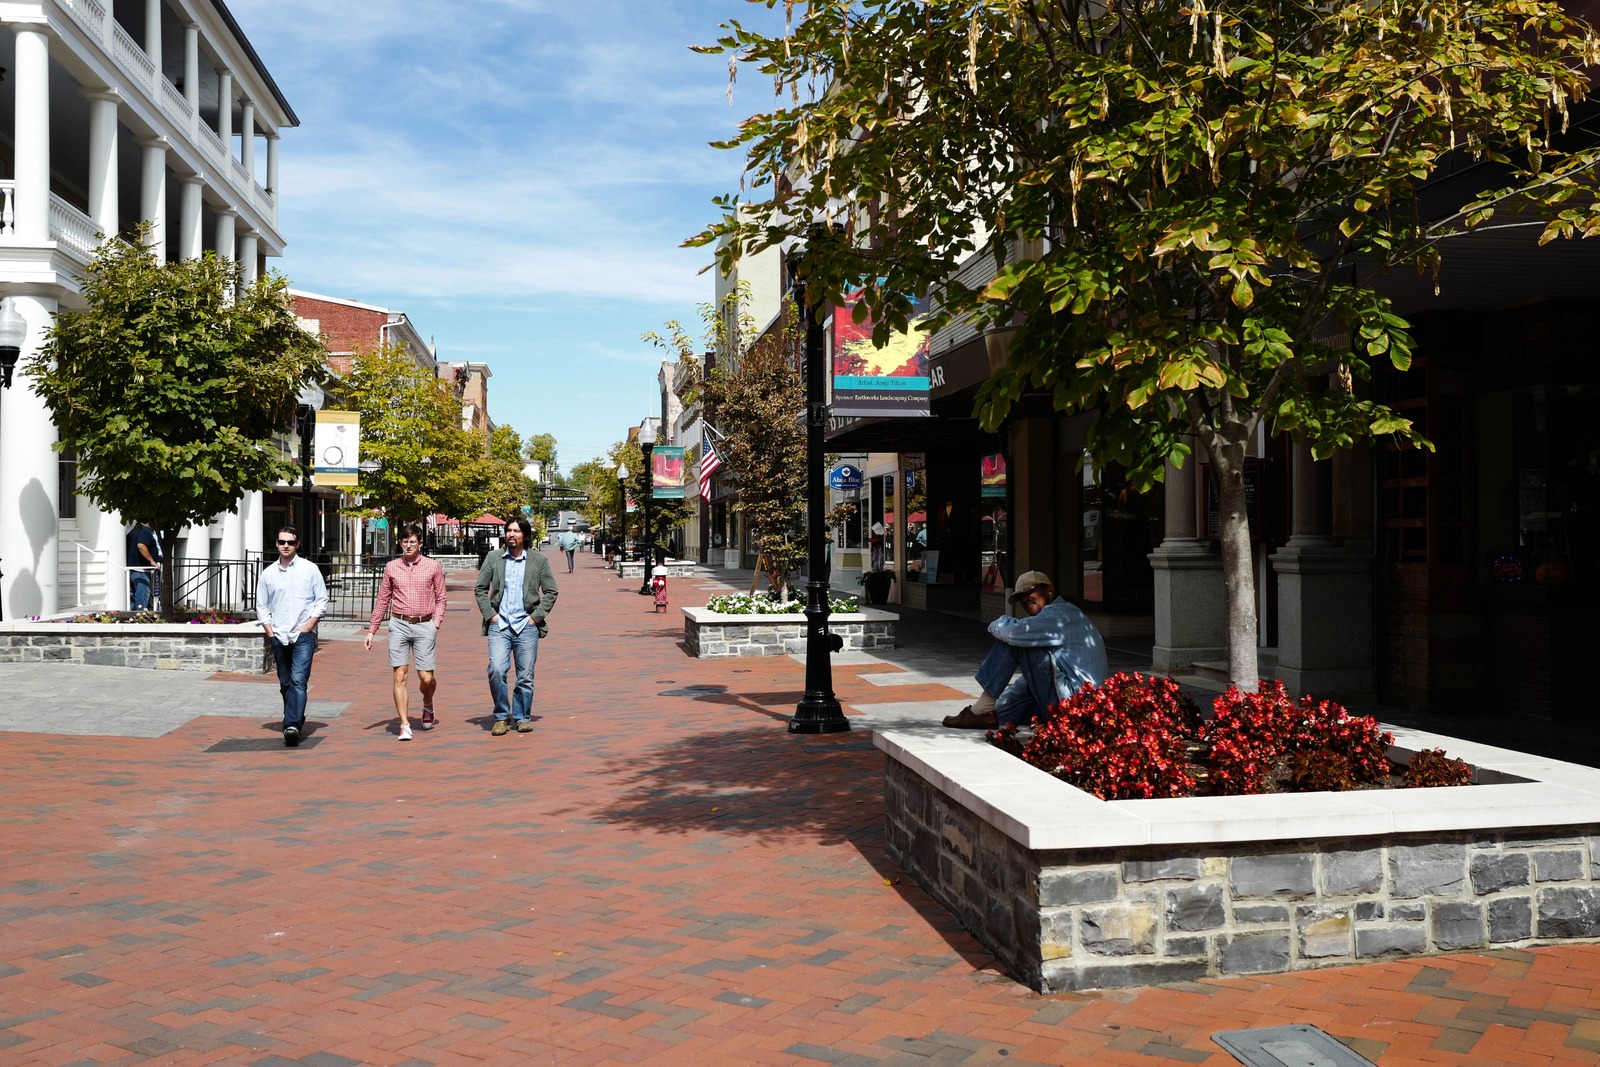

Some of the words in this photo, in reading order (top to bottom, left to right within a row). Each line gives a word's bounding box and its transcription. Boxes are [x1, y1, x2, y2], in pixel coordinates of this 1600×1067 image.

[930, 365, 946, 389] AR
[879, 394, 907, 402] Landscaping
[907, 395, 929, 403] Company
[1491, 563, 1522, 577] OPEN
